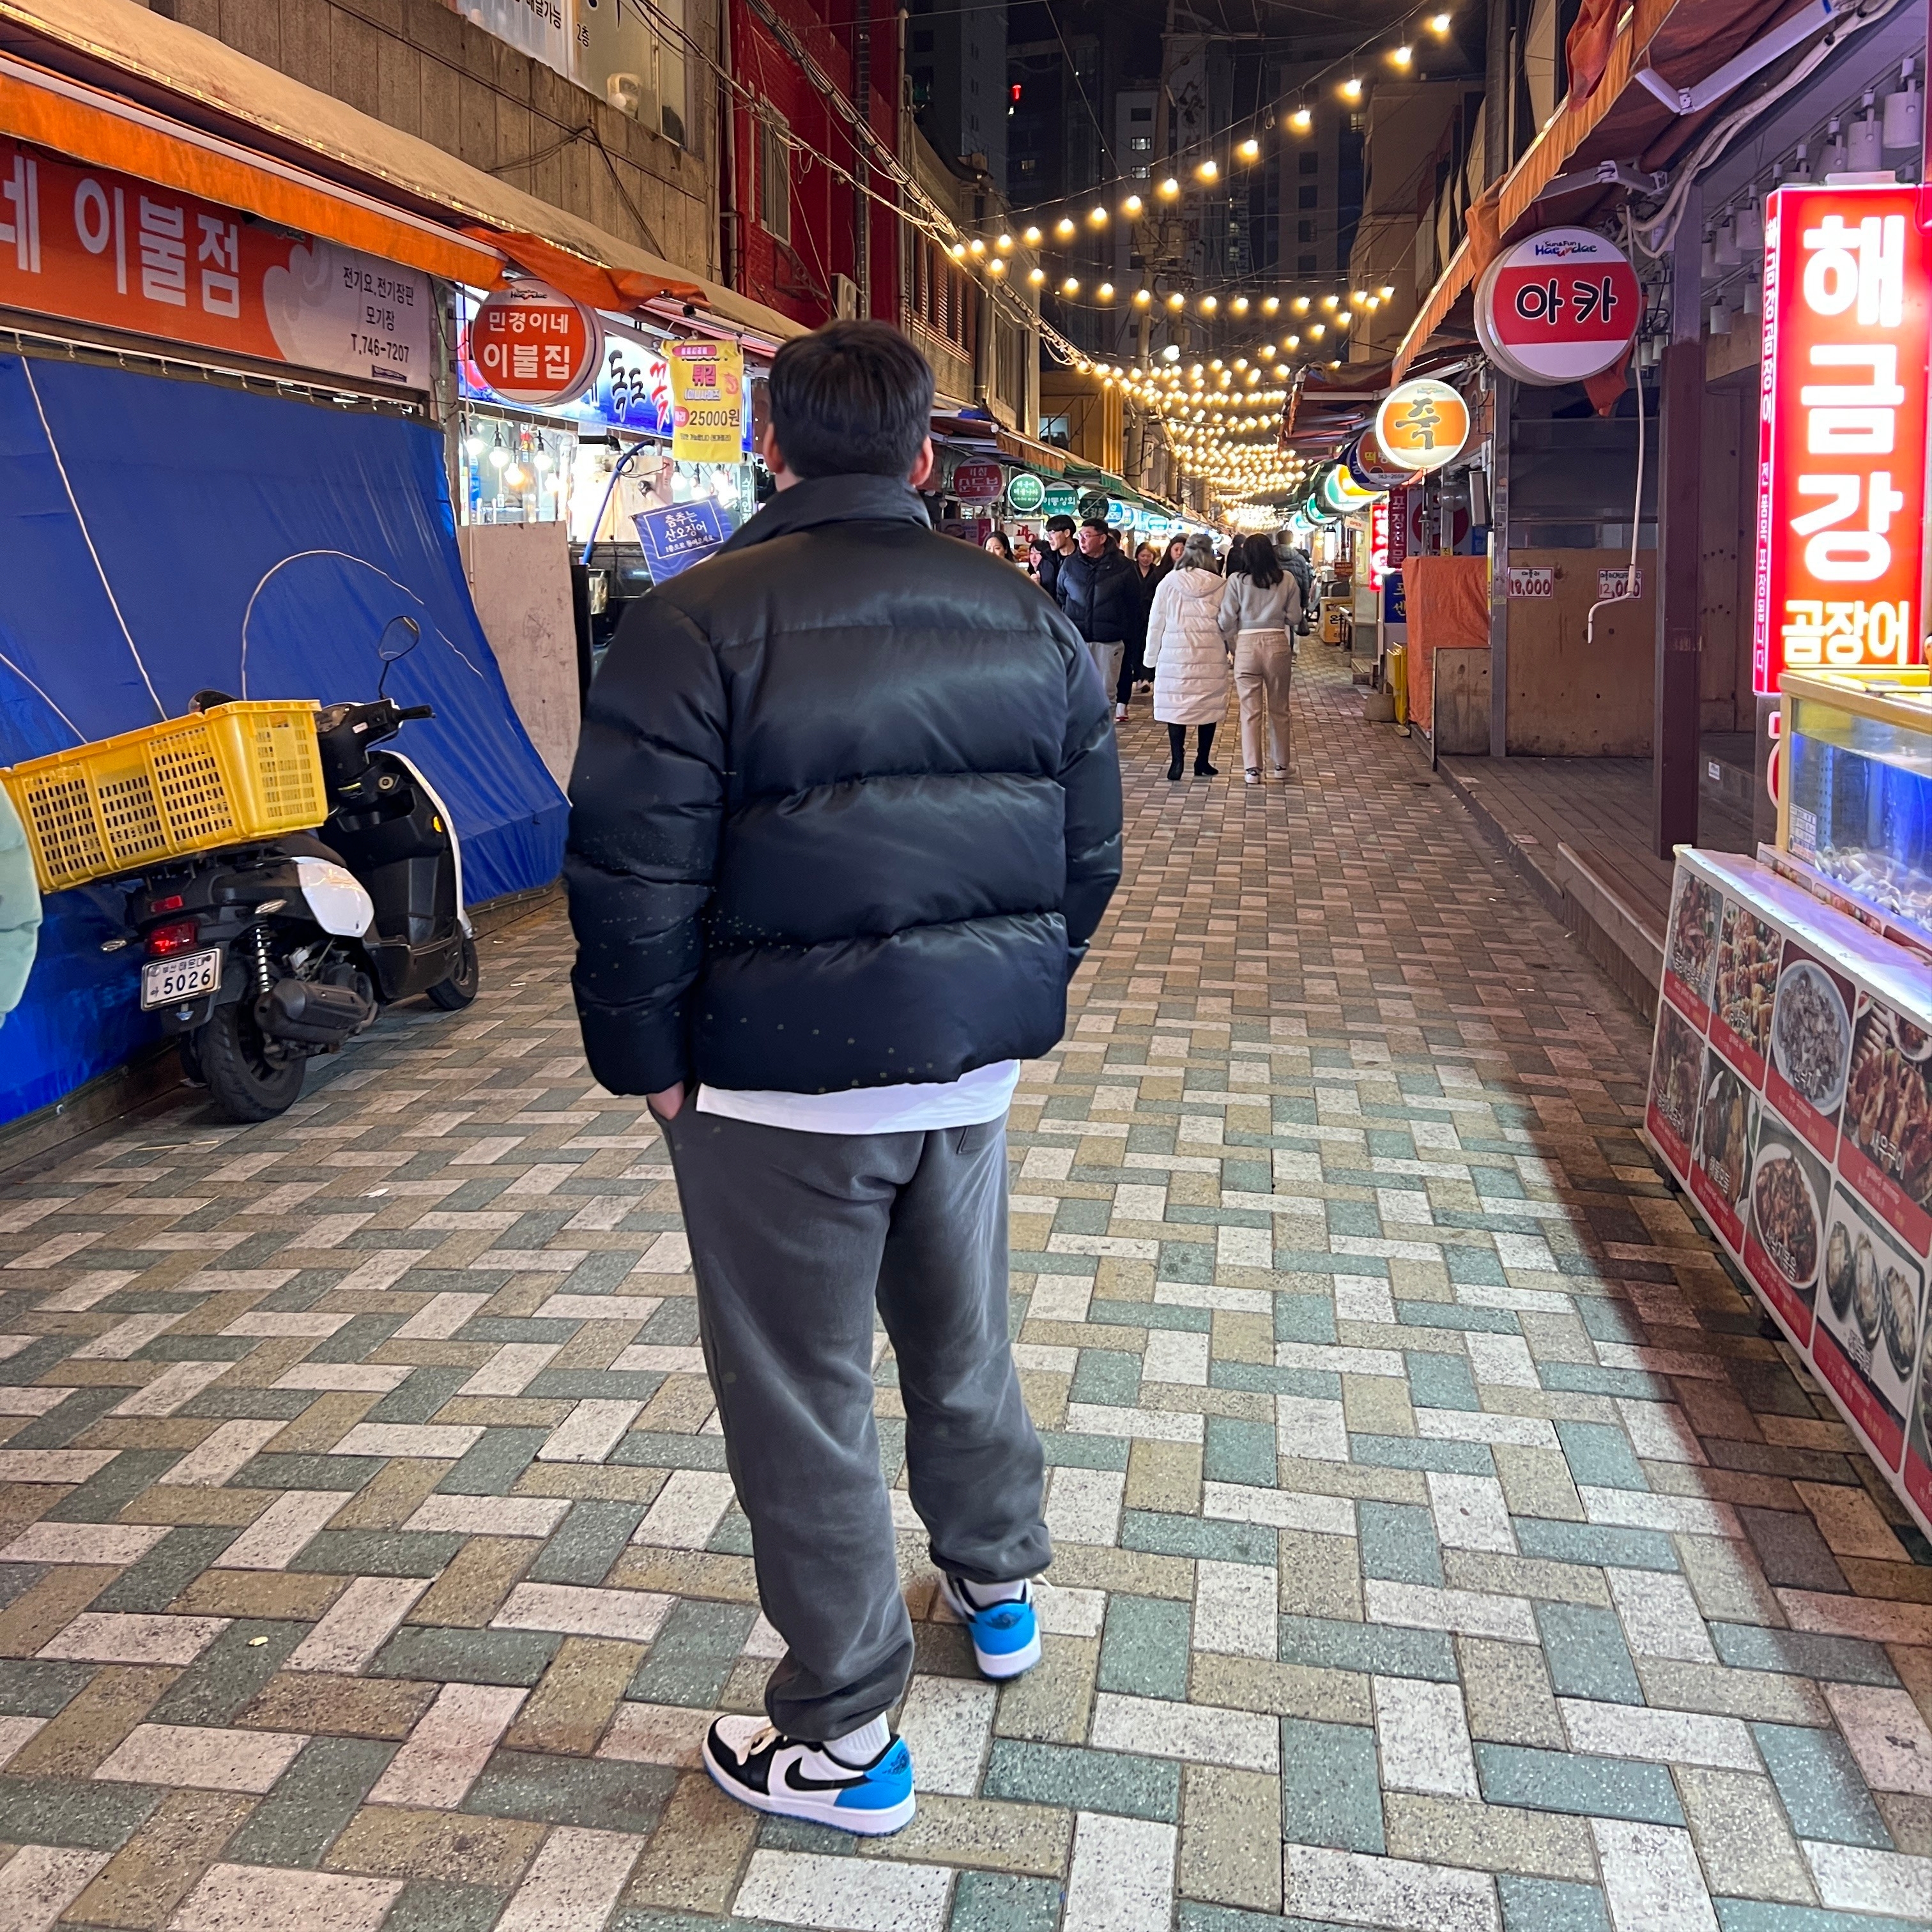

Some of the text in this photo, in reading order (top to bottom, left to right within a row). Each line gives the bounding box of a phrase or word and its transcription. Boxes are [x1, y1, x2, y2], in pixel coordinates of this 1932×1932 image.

[577, 24, 589, 47] 2층
[74, 178, 240, 318] 이불점
[1535, 242, 1597, 257] Haeundae
[1514, 275, 1618, 325] 아카
[366, 306, 395, 331] 모기장
[489, 312, 569, 334] 민경이네
[351, 333, 410, 363] T.746-7207
[484, 343, 570, 379] 이불집
[692, 364, 716, 387] 튀김
[1790, 215, 1905, 581] 해금강
[689, 409, 740, 427] 25000원
[1395, 397, 1441, 450] 죽
[665, 510, 698, 528] 춤추는
[665, 521, 708, 542] 산오징어
[1782, 599, 1910, 665] 곰장어
[164, 968, 211, 995] 5026
